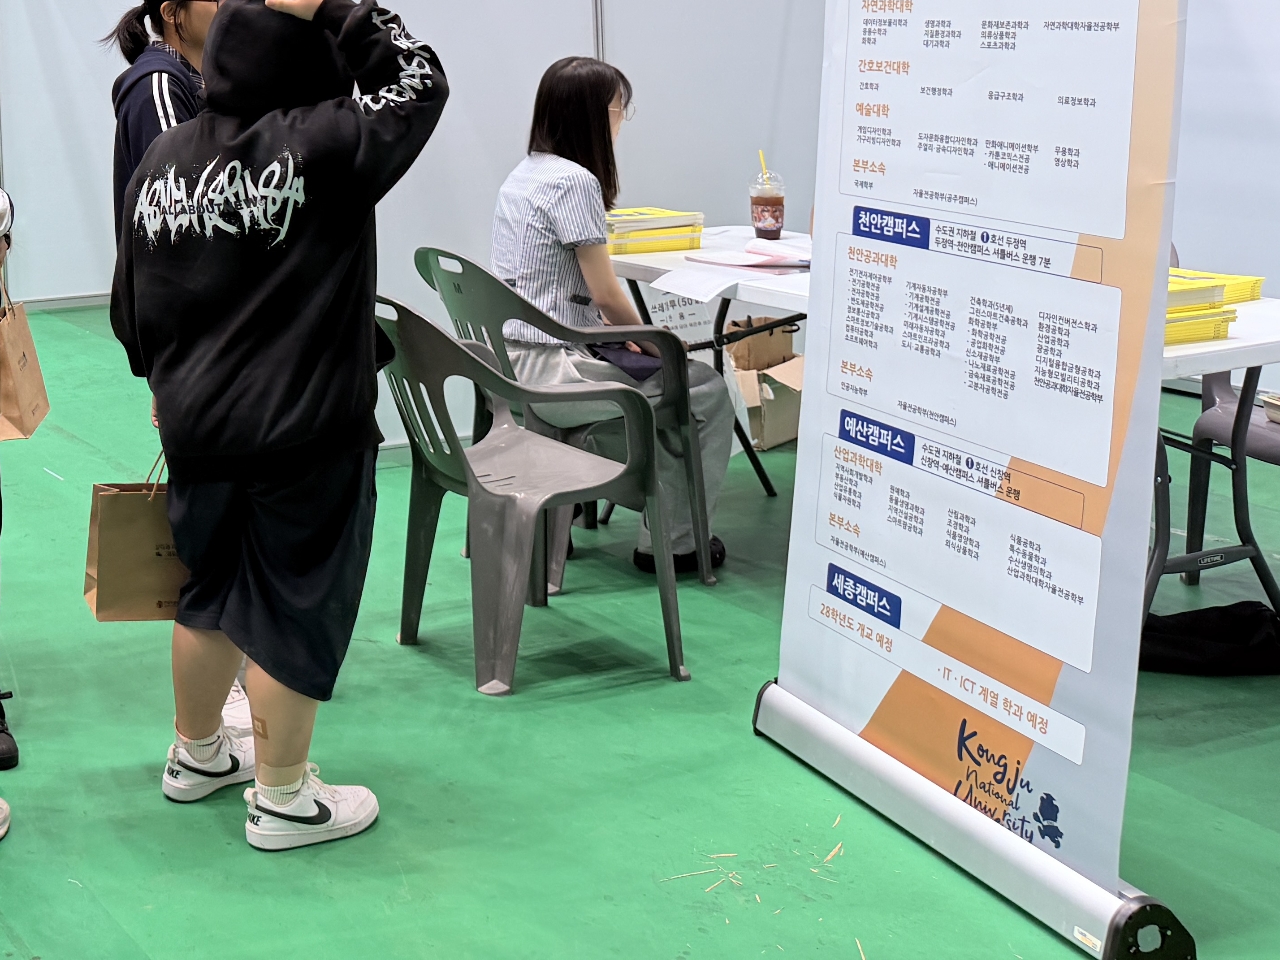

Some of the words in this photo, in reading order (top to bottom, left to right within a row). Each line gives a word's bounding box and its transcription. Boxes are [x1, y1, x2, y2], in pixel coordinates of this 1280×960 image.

[861, 0, 913, 14] 자연과학대학
[924, 19, 952, 29] 생명과학과
[1043, 21, 1120, 32] 자연과학대학자율전공학부
[923, 29, 962, 39] 지질환경과학과
[980, 30, 1017, 41] 의류상품학과
[923, 40, 950, 49] 대기과학과
[979, 41, 1016, 51] 스포츠과학과
[858, 59, 911, 76] 간호보건대학
[920, 86, 953, 97] 보건행정학과
[987, 90, 1024, 103] 응급구조학과
[855, 102, 890, 118] 예술대학
[1057, 95, 1097, 108] 의료정보학과
[985, 139, 1039, 154] 만화애니메이션학부
[1054, 146, 1080, 158] 무용학과
[988, 150, 1030, 164] 카툰코믹스전공
[1054, 157, 1080, 170] 영상학과
[852, 158, 887, 176] 본부소속
[987, 161, 1030, 175] 애니메이션전공
[853, 179, 874, 190] 국제학부
[912, 188, 978, 207] 자율전공학부(공주캠퍼스)
[858, 211, 920, 239] 천안캠퍼스
[935, 224, 955, 236] 수도권
[956, 227, 977, 241] 지하철
[1005, 237, 1027, 250] 두정역
[847, 246, 898, 270] 천안공과대학
[934, 237, 991, 256] 두정역-천안캠퍼스
[992, 248, 1020, 262] 셔틀버스
[1022, 253, 1037, 266] 운행
[1038, 256, 1051, 269] 7분
[968, 306, 1029, 329] 그린스마트건축공학과
[968, 316, 998, 331] 화학공학부
[1038, 311, 1098, 333] 디자인컨버전스학과
[971, 328, 1007, 345] 화학공학전공
[1038, 322, 1070, 338] 환경공학과
[1037, 332, 1070, 349] 산업공학과
[965, 348, 1001, 364] 신소재공학부
[1036, 343, 1062, 359] 광공학과
[840, 359, 873, 382] 본부소속
[1035, 354, 1102, 380] 디지털융합금형공학과
[1034, 365, 1101, 391] 지능형모빌리티공학과
[897, 399, 957, 427] 자율전공학부(천안캠퍼스)
[844, 416, 905, 453] 예산캠퍼스
[921, 442, 941, 458] 수도권
[941, 449, 962, 465] 지하철
[990, 466, 1011, 484] 신창역
[834, 445, 883, 476] 산업과학대학
[920, 455, 975, 484] 신창역-예산캠퍼스
[976, 476, 1005, 494] 셔틀버스
[1006, 486, 1020, 501] 운행
[828, 511, 861, 538] 본부소속
[946, 518, 970, 535] 조경학과
[947, 508, 976, 528] 산림과학과
[945, 528, 980, 551] 식품영양학과
[1009, 533, 1042, 554] 식품공학과
[944, 539, 979, 561] 외식상품학과
[1008, 543, 1048, 567] 특수동물학과
[1008, 554, 1052, 581] 수산생명의학과
[832, 572, 891, 617] 세종캠퍼스
[1006, 565, 1084, 606] 산업과학대학자율전공학부
[820, 602, 855, 632] 28학년도
[856, 623, 873, 642] 개교
[875, 631, 893, 653] 예정
[942, 666, 952, 681] IT
[959, 676, 977, 695] ICT
[978, 684, 999, 709] 계열
[1002, 696, 1023, 722] 학과
[1026, 709, 1049, 735] 예정
[956, 718, 1033, 795] Kongju
